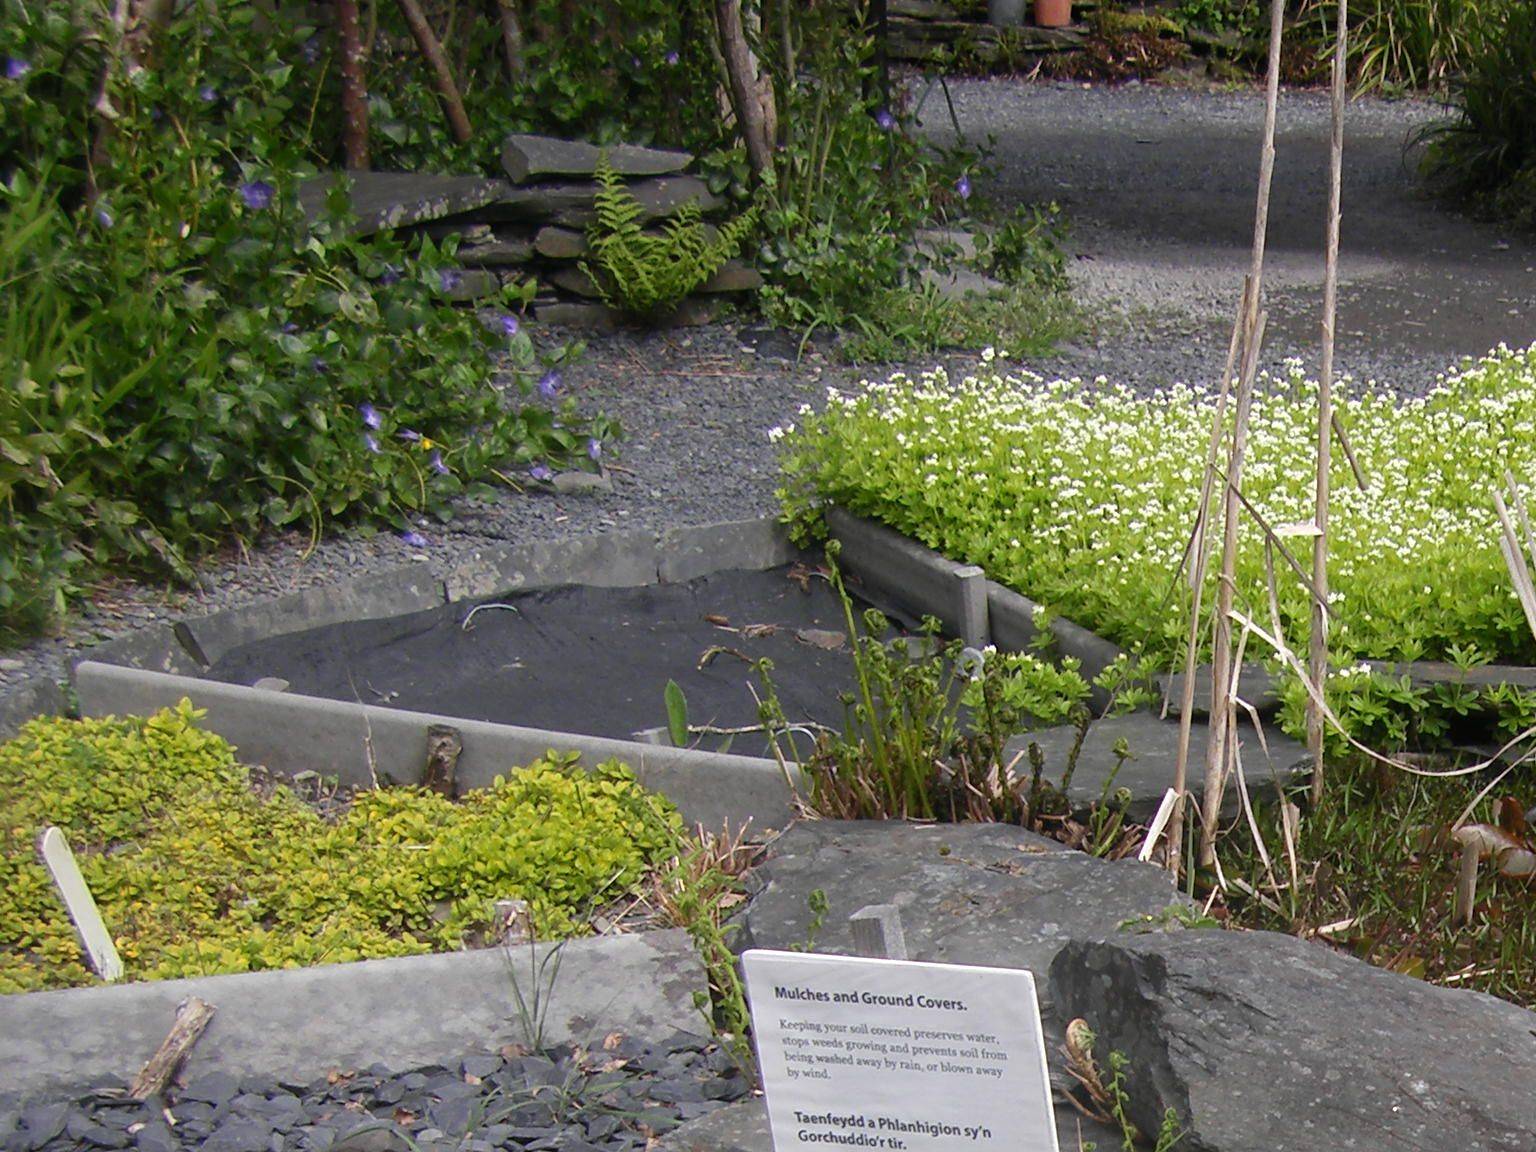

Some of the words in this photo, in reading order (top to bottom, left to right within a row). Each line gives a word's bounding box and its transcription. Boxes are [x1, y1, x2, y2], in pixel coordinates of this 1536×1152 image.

[774, 987, 830, 1002] Mulches
[833, 991, 858, 1003] and
[861, 993, 913, 1007] Ground
[917, 996, 967, 1011] Covers.
[779, 1020, 822, 1034] Keeping
[824, 1024, 847, 1034] your
[850, 1023, 868, 1034] soil
[870, 1027, 911, 1038] covered
[914, 1029, 964, 1041] preserves
[966, 1034, 1000, 1045] water,
[782, 1037, 809, 1048] stops
[812, 1038, 844, 1048] weeds
[845, 1039, 888, 1053] growing
[890, 1043, 909, 1053] and
[911, 1045, 957, 1057] prevents
[960, 1048, 978, 1058] soil
[981, 1049, 1008, 1060] from
[785, 1052, 813, 1064] being
[816, 1054, 854, 1065] washed
[856, 1057, 882, 1069] away
[884, 1058, 898, 1070] by
[900, 1060, 924, 1071] rain,
[926, 1063, 938, 1071] or
[940, 1063, 973, 1074] blown
[976, 1067, 1003, 1079] away
[787, 1067, 800, 1079] by
[802, 1069, 831, 1080] wind.
[794, 1112, 865, 1129] Taenfeydd
[878, 1118, 961, 1137] Phlanhigion
[888, 1138, 907, 1150] tir.
